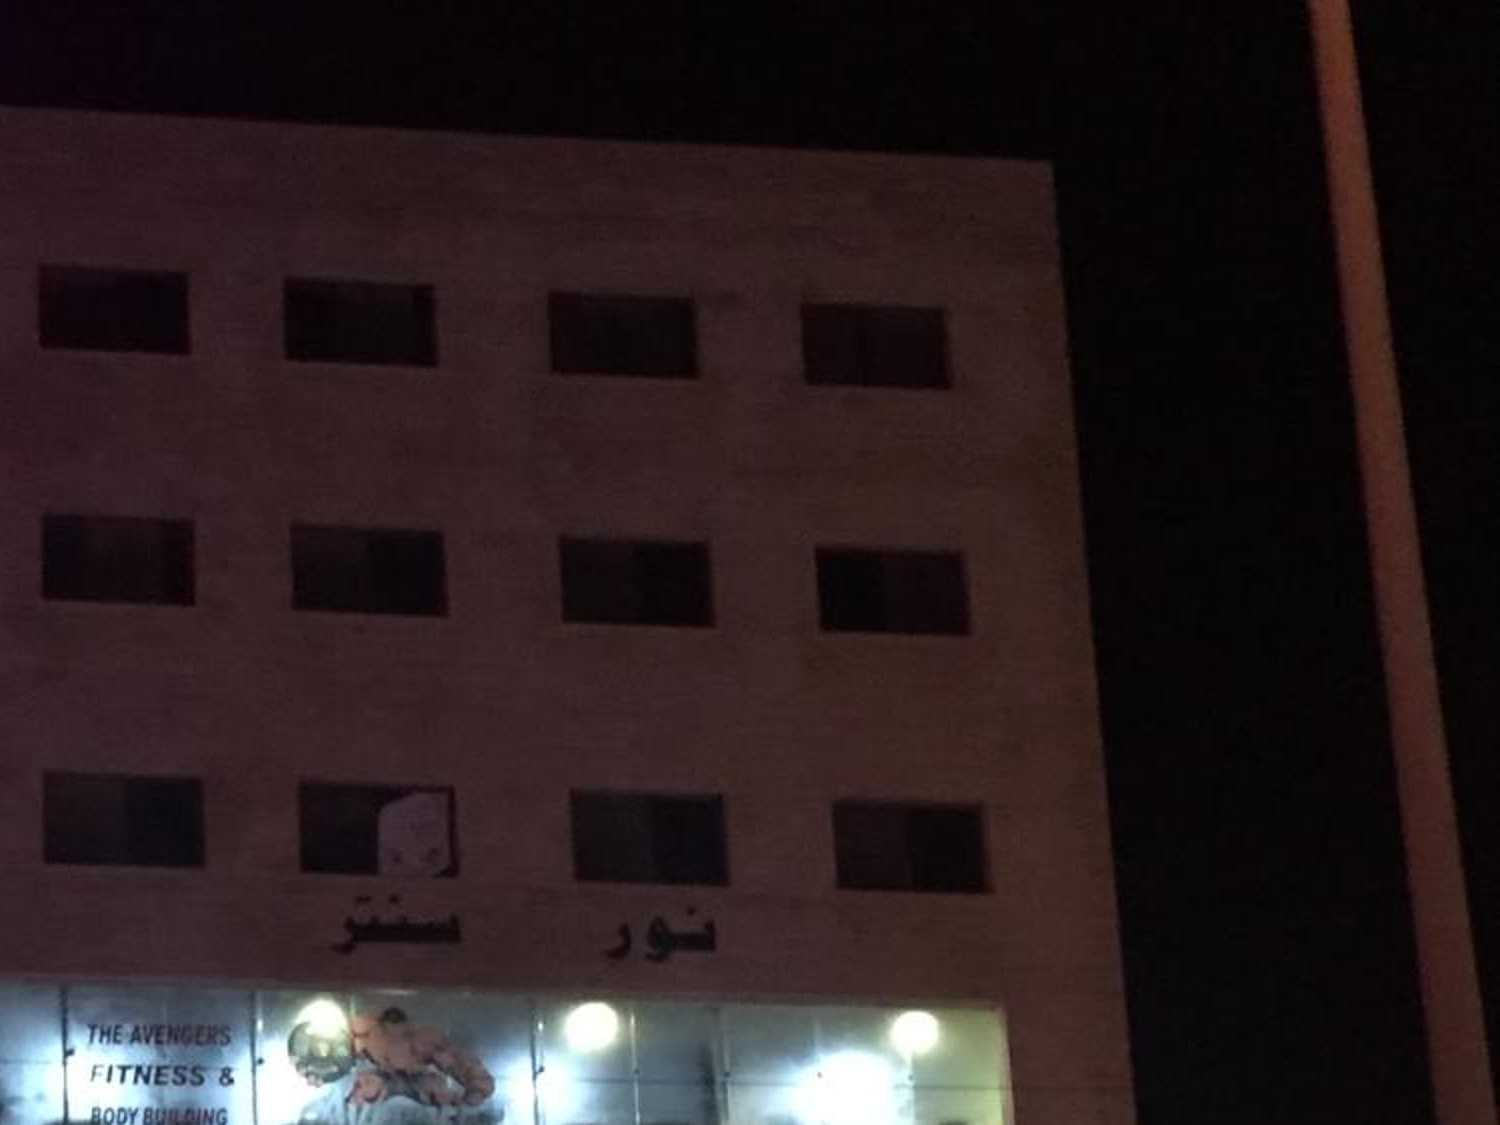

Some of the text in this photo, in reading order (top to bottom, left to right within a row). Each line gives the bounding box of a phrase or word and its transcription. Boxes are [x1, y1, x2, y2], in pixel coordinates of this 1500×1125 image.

[87, 1023, 232, 1047] THE AVENGERS
[91, 1063, 235, 1087] FITNESS &
